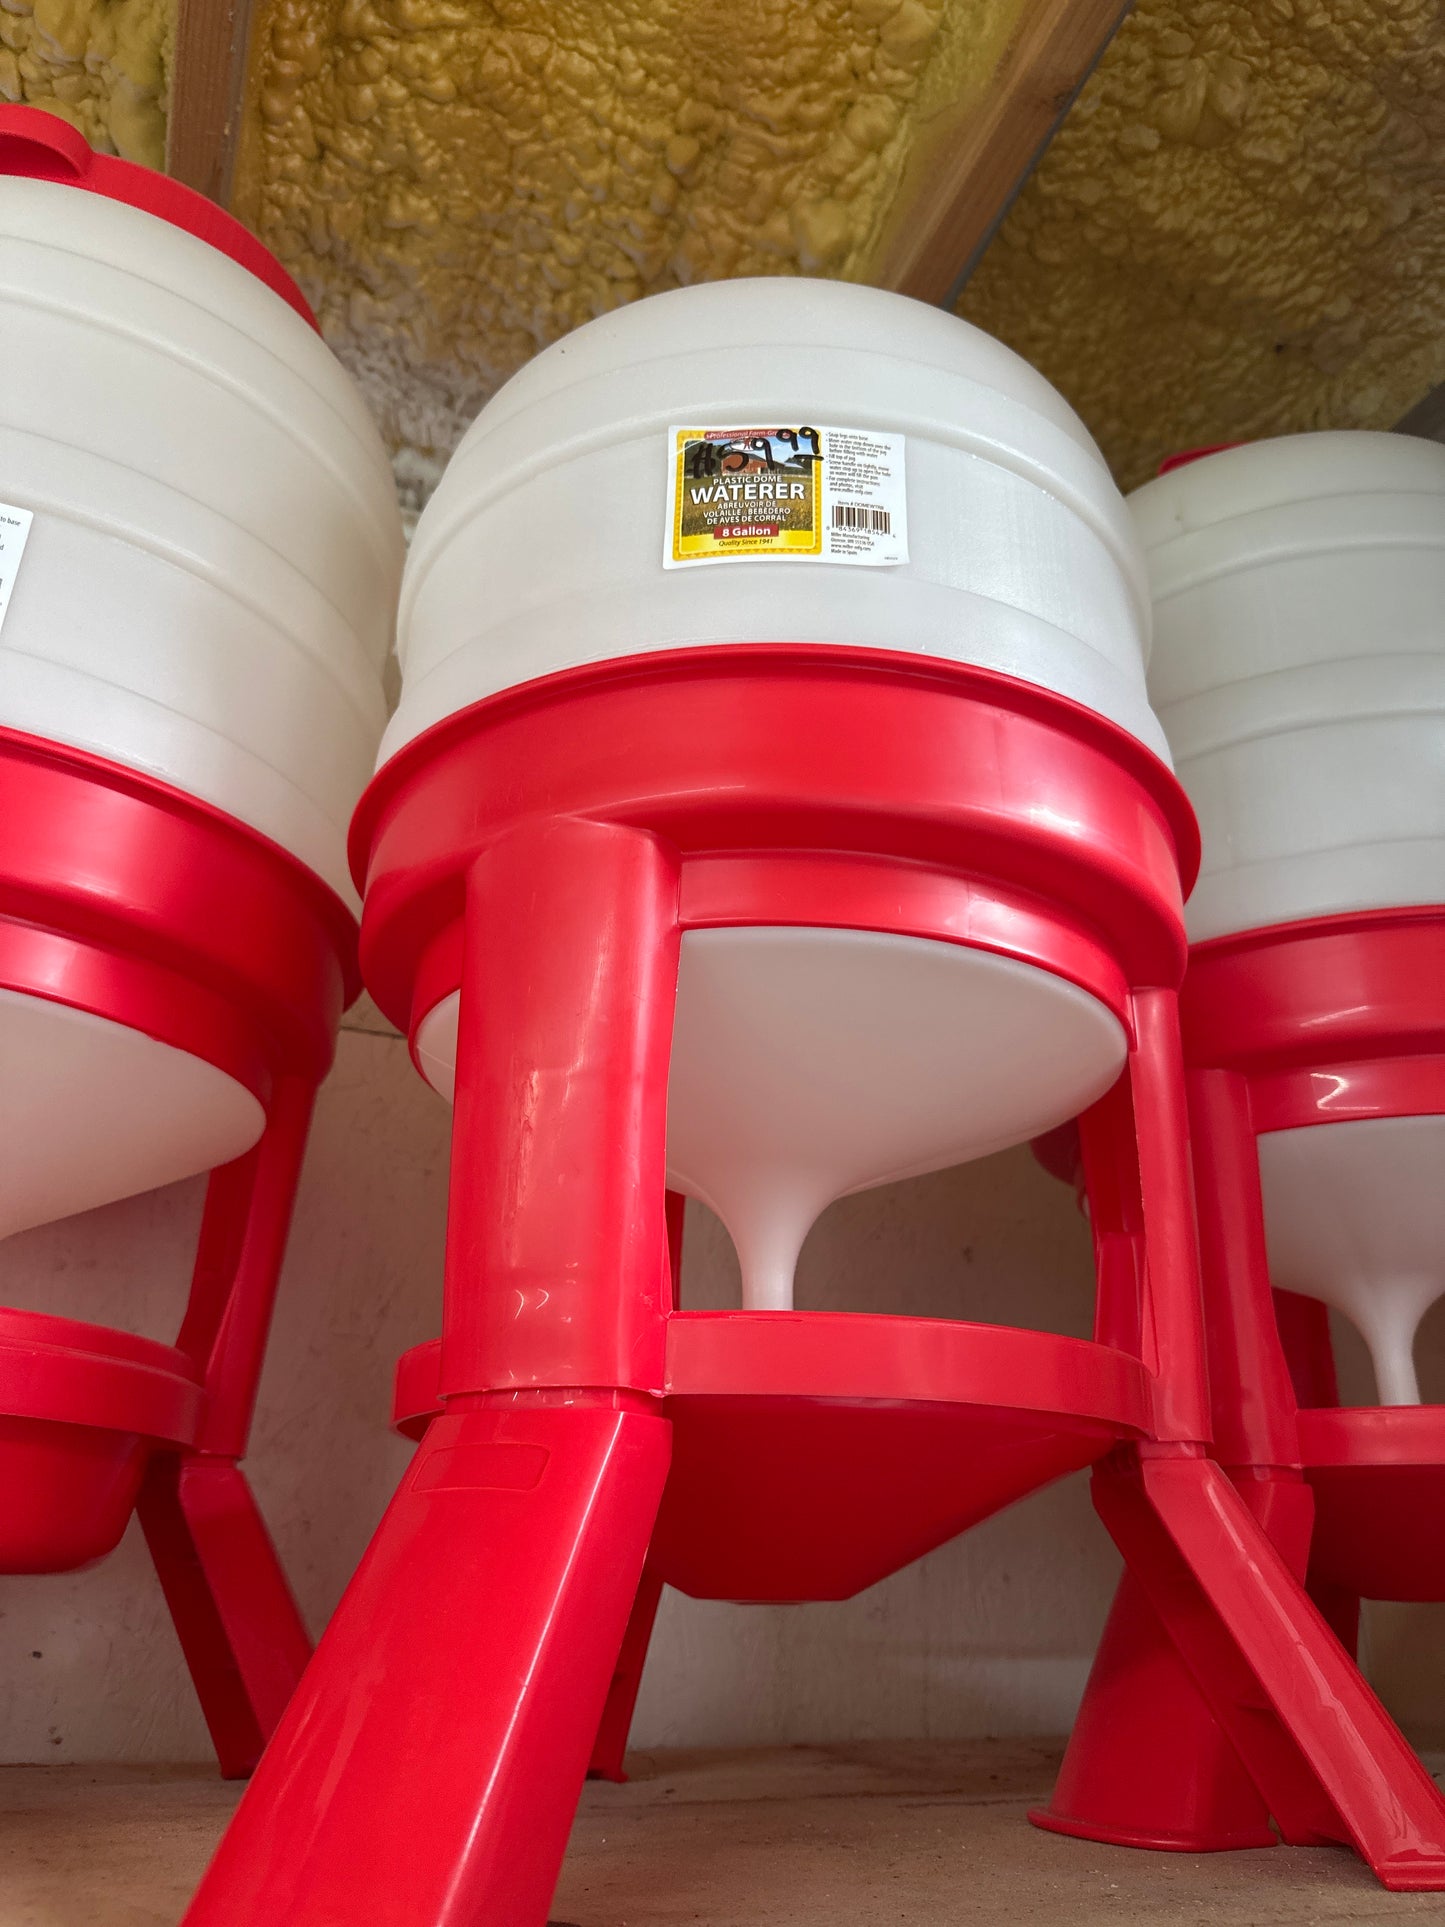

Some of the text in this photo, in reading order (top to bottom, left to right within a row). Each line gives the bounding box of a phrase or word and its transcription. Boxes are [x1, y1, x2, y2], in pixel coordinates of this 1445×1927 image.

[713, 475, 782, 485] PLASTIC DOME
[690, 483, 805, 505] WATERER
[717, 501, 764, 510] ABREUVOIR
[703, 509, 741, 518] VOLAILLE
[707, 517, 718, 525] DE
[720, 516, 740, 524] AVES
[722, 526, 771, 537] 8 Gallon
[718, 539, 741, 547] Quality
